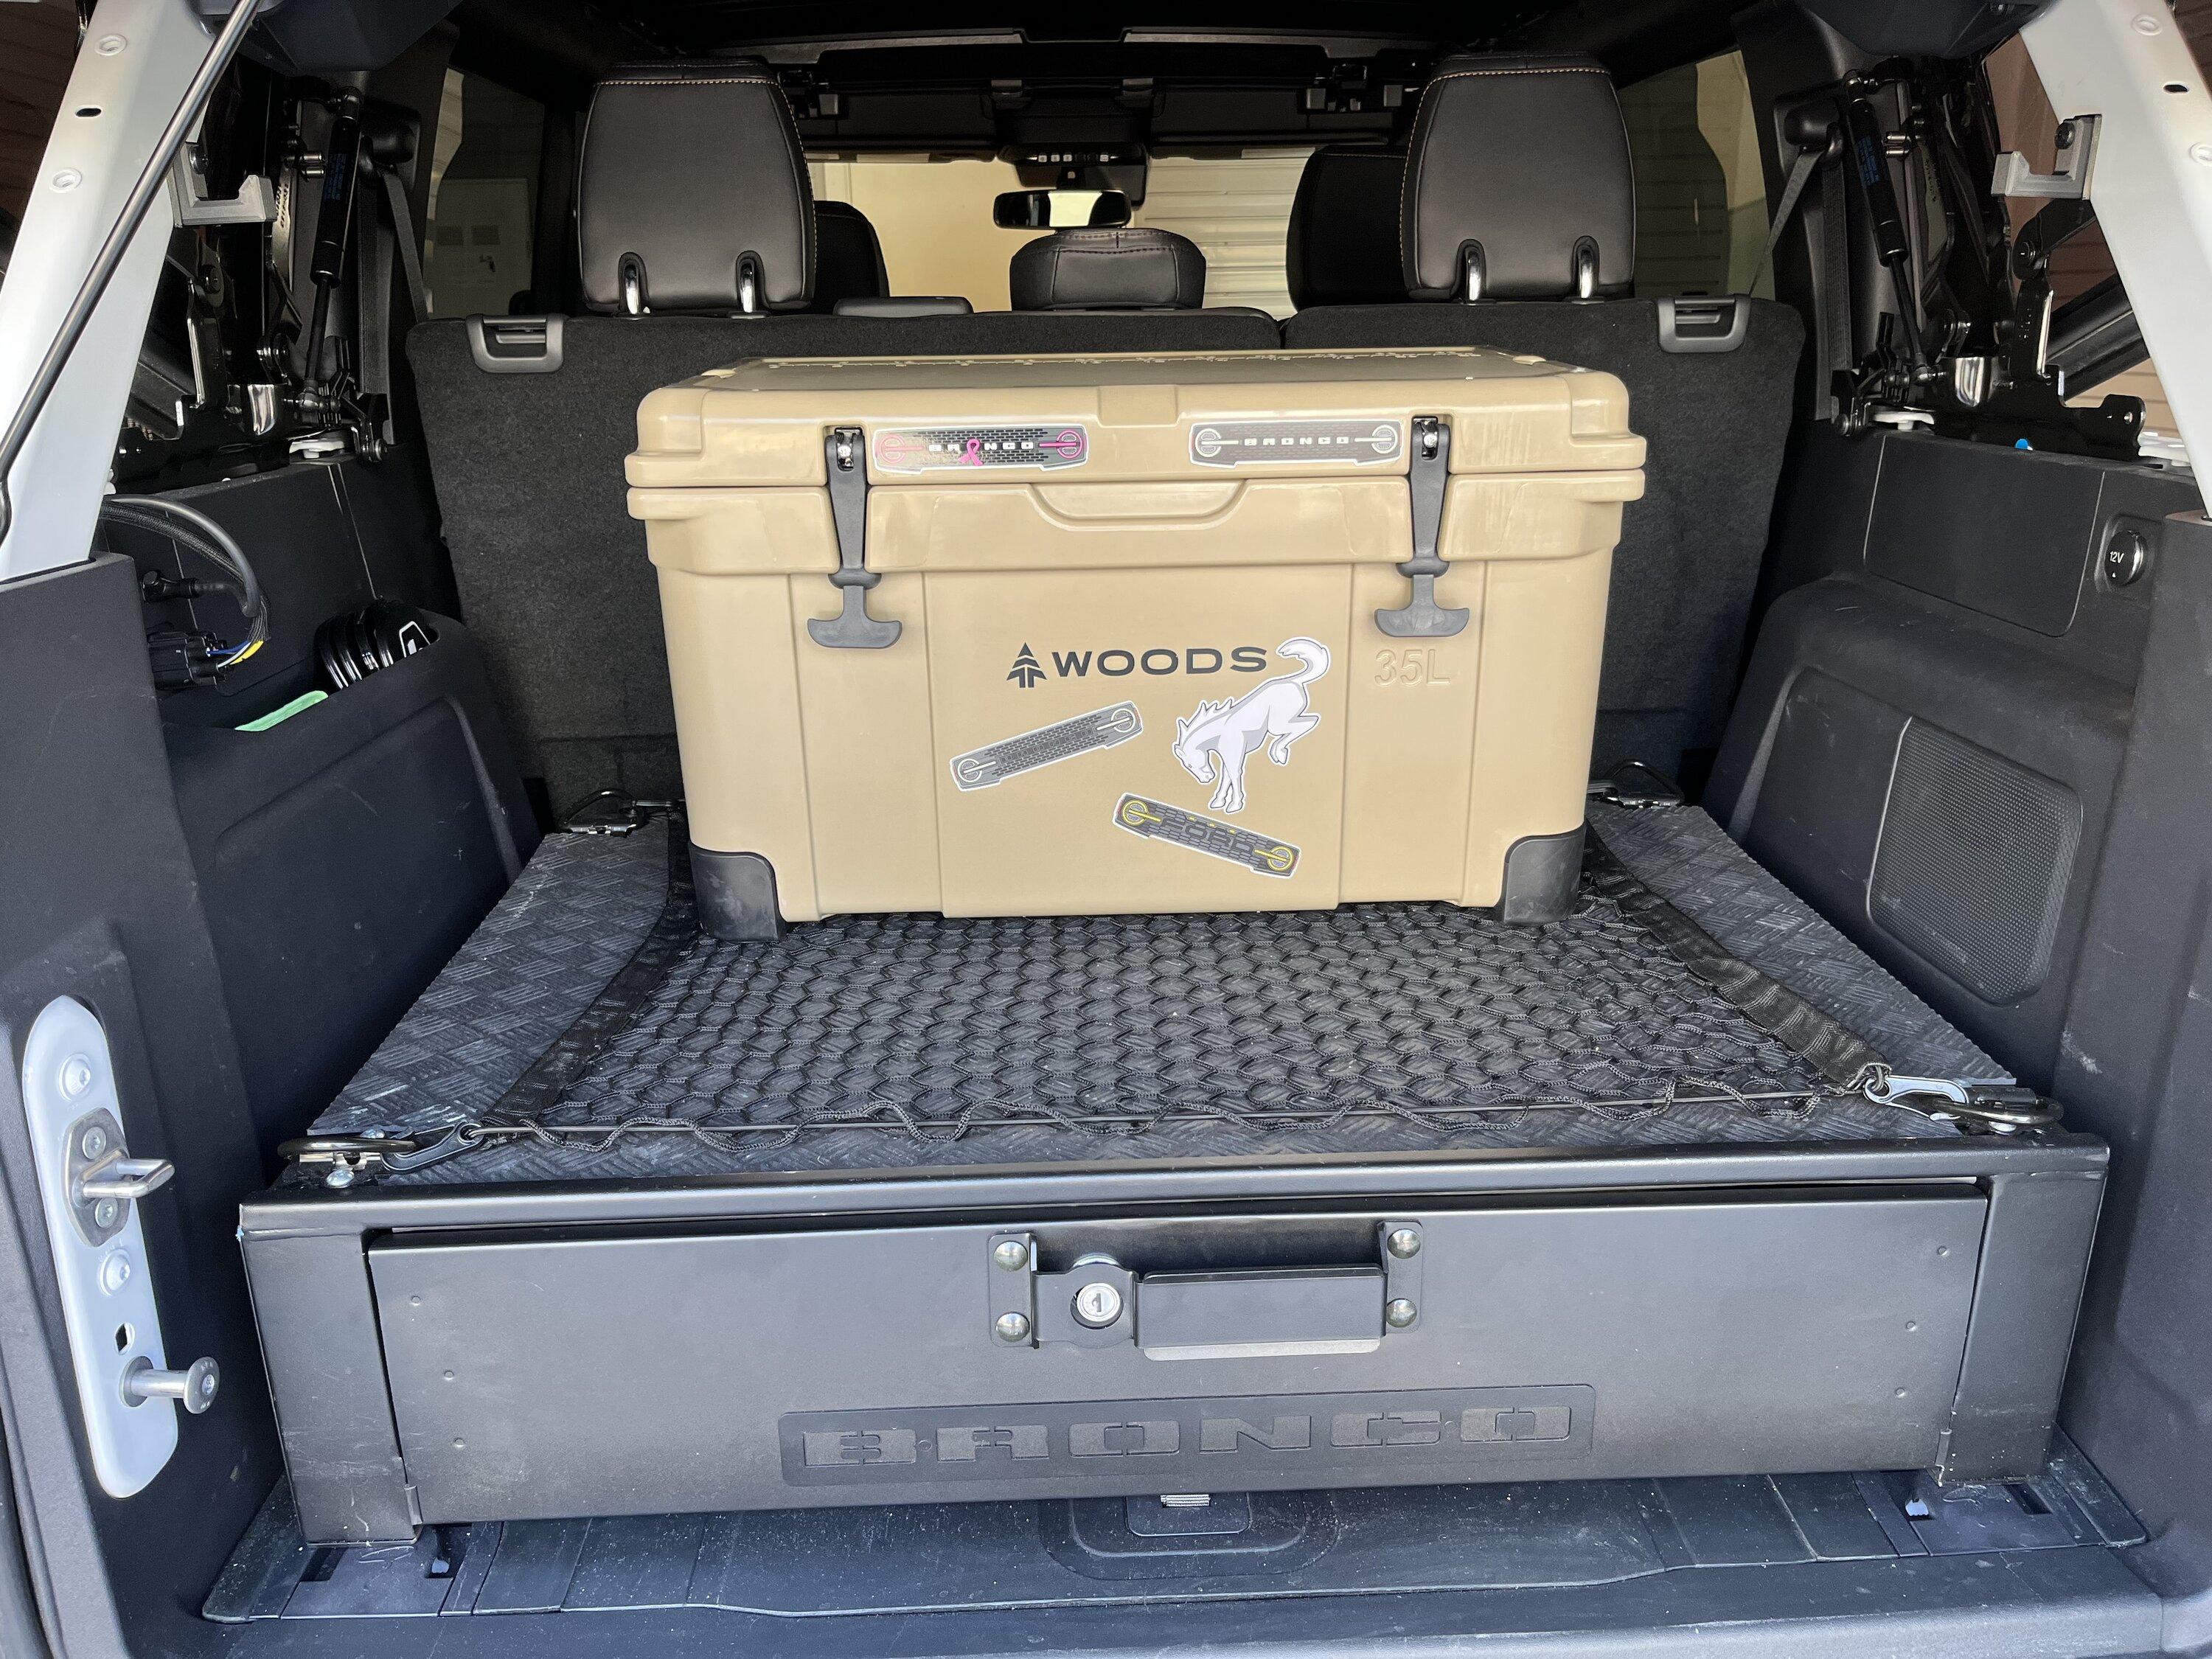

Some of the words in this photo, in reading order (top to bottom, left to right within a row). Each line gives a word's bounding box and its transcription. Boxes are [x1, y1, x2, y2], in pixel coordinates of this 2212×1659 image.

[928, 442, 1034, 452] BRNCO
[1244, 437, 1349, 446] BRONCO
[2110, 551, 2125, 564] 12V
[1051, 647, 1267, 678] WOODS
[1374, 649, 1451, 686] 35L
[1161, 818, 1254, 854] FORD
[802, 1405, 1572, 1468] BRONCO
